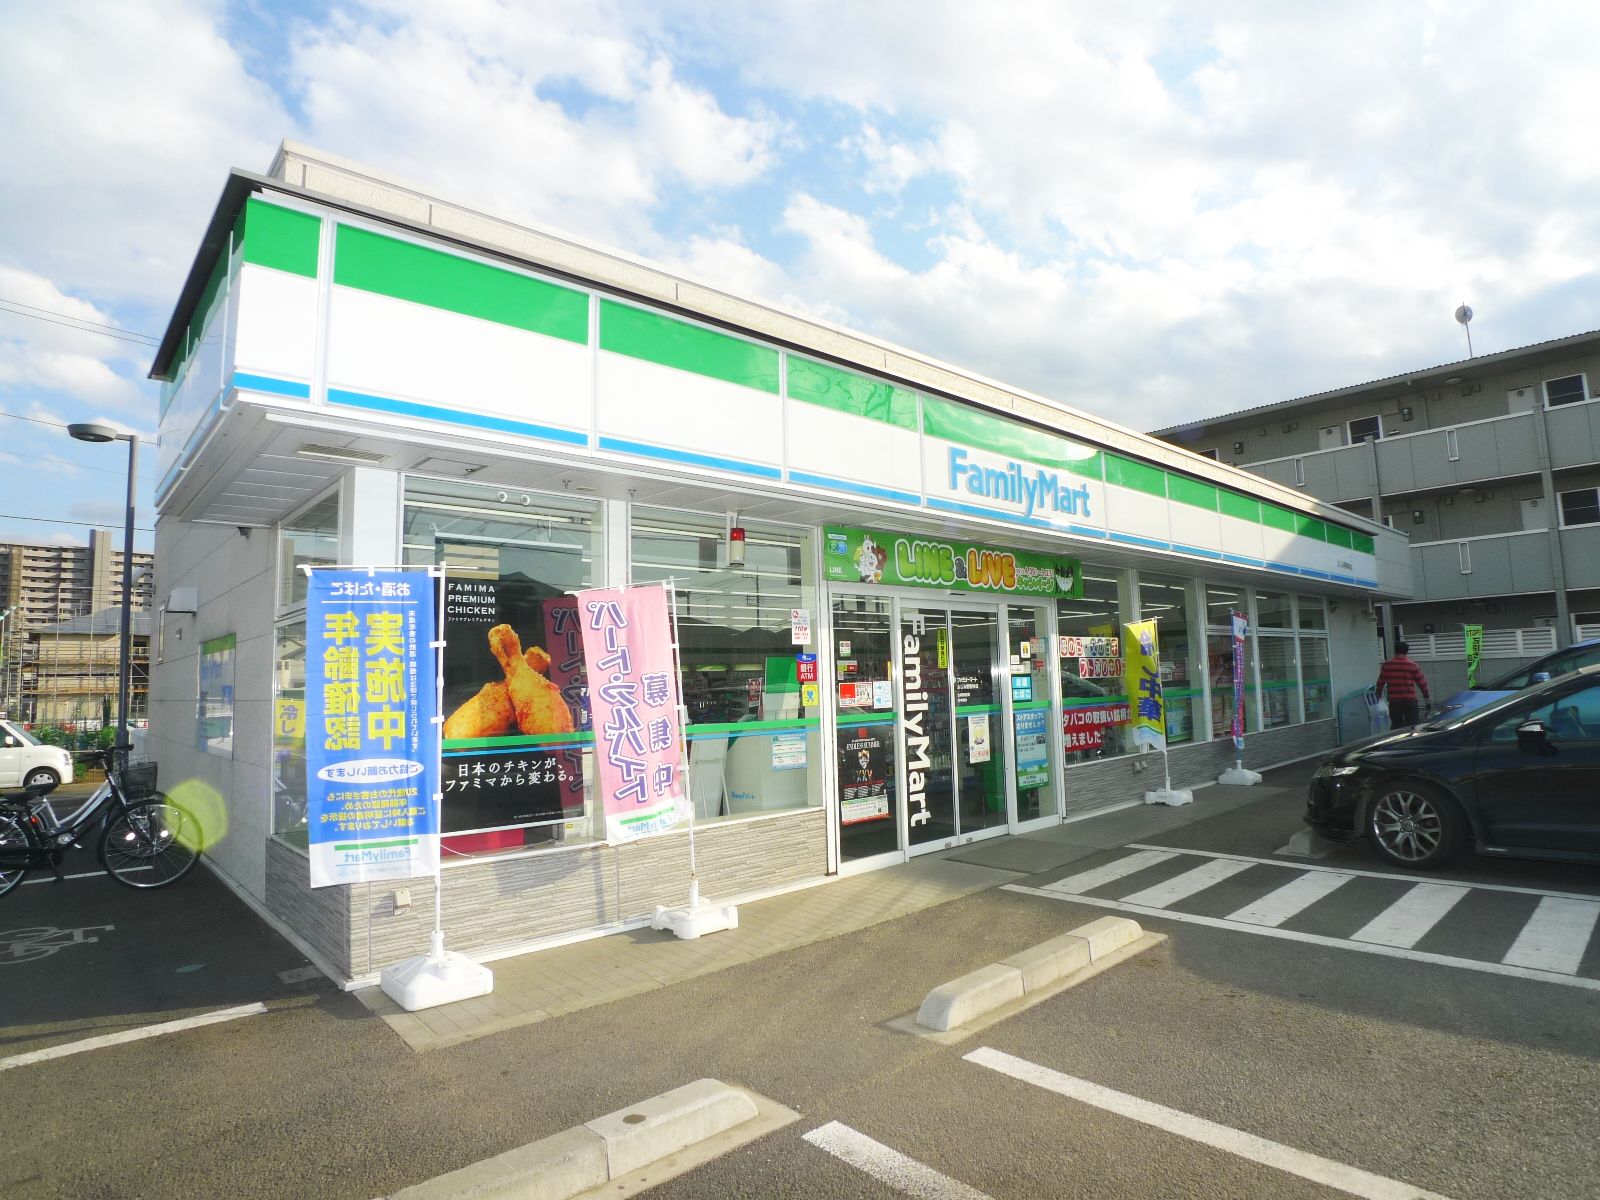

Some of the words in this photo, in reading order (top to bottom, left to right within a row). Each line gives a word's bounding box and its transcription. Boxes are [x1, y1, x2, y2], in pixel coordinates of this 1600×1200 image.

[948, 446, 1090, 517] FamilyMart
[897, 541, 954, 583] LINE
[967, 549, 1016, 588] LIVE
[448, 583, 495, 593] FAMIMA
[448, 594, 496, 604] PREMIUM
[447, 605, 496, 615] CHICKEN
[800, 663, 813, 673] 銀行
[903, 612, 932, 828] FamilyMart
[458, 757, 564, 778] 日本のチキンが、
[446, 769, 574, 792] ファミマから変わる。
